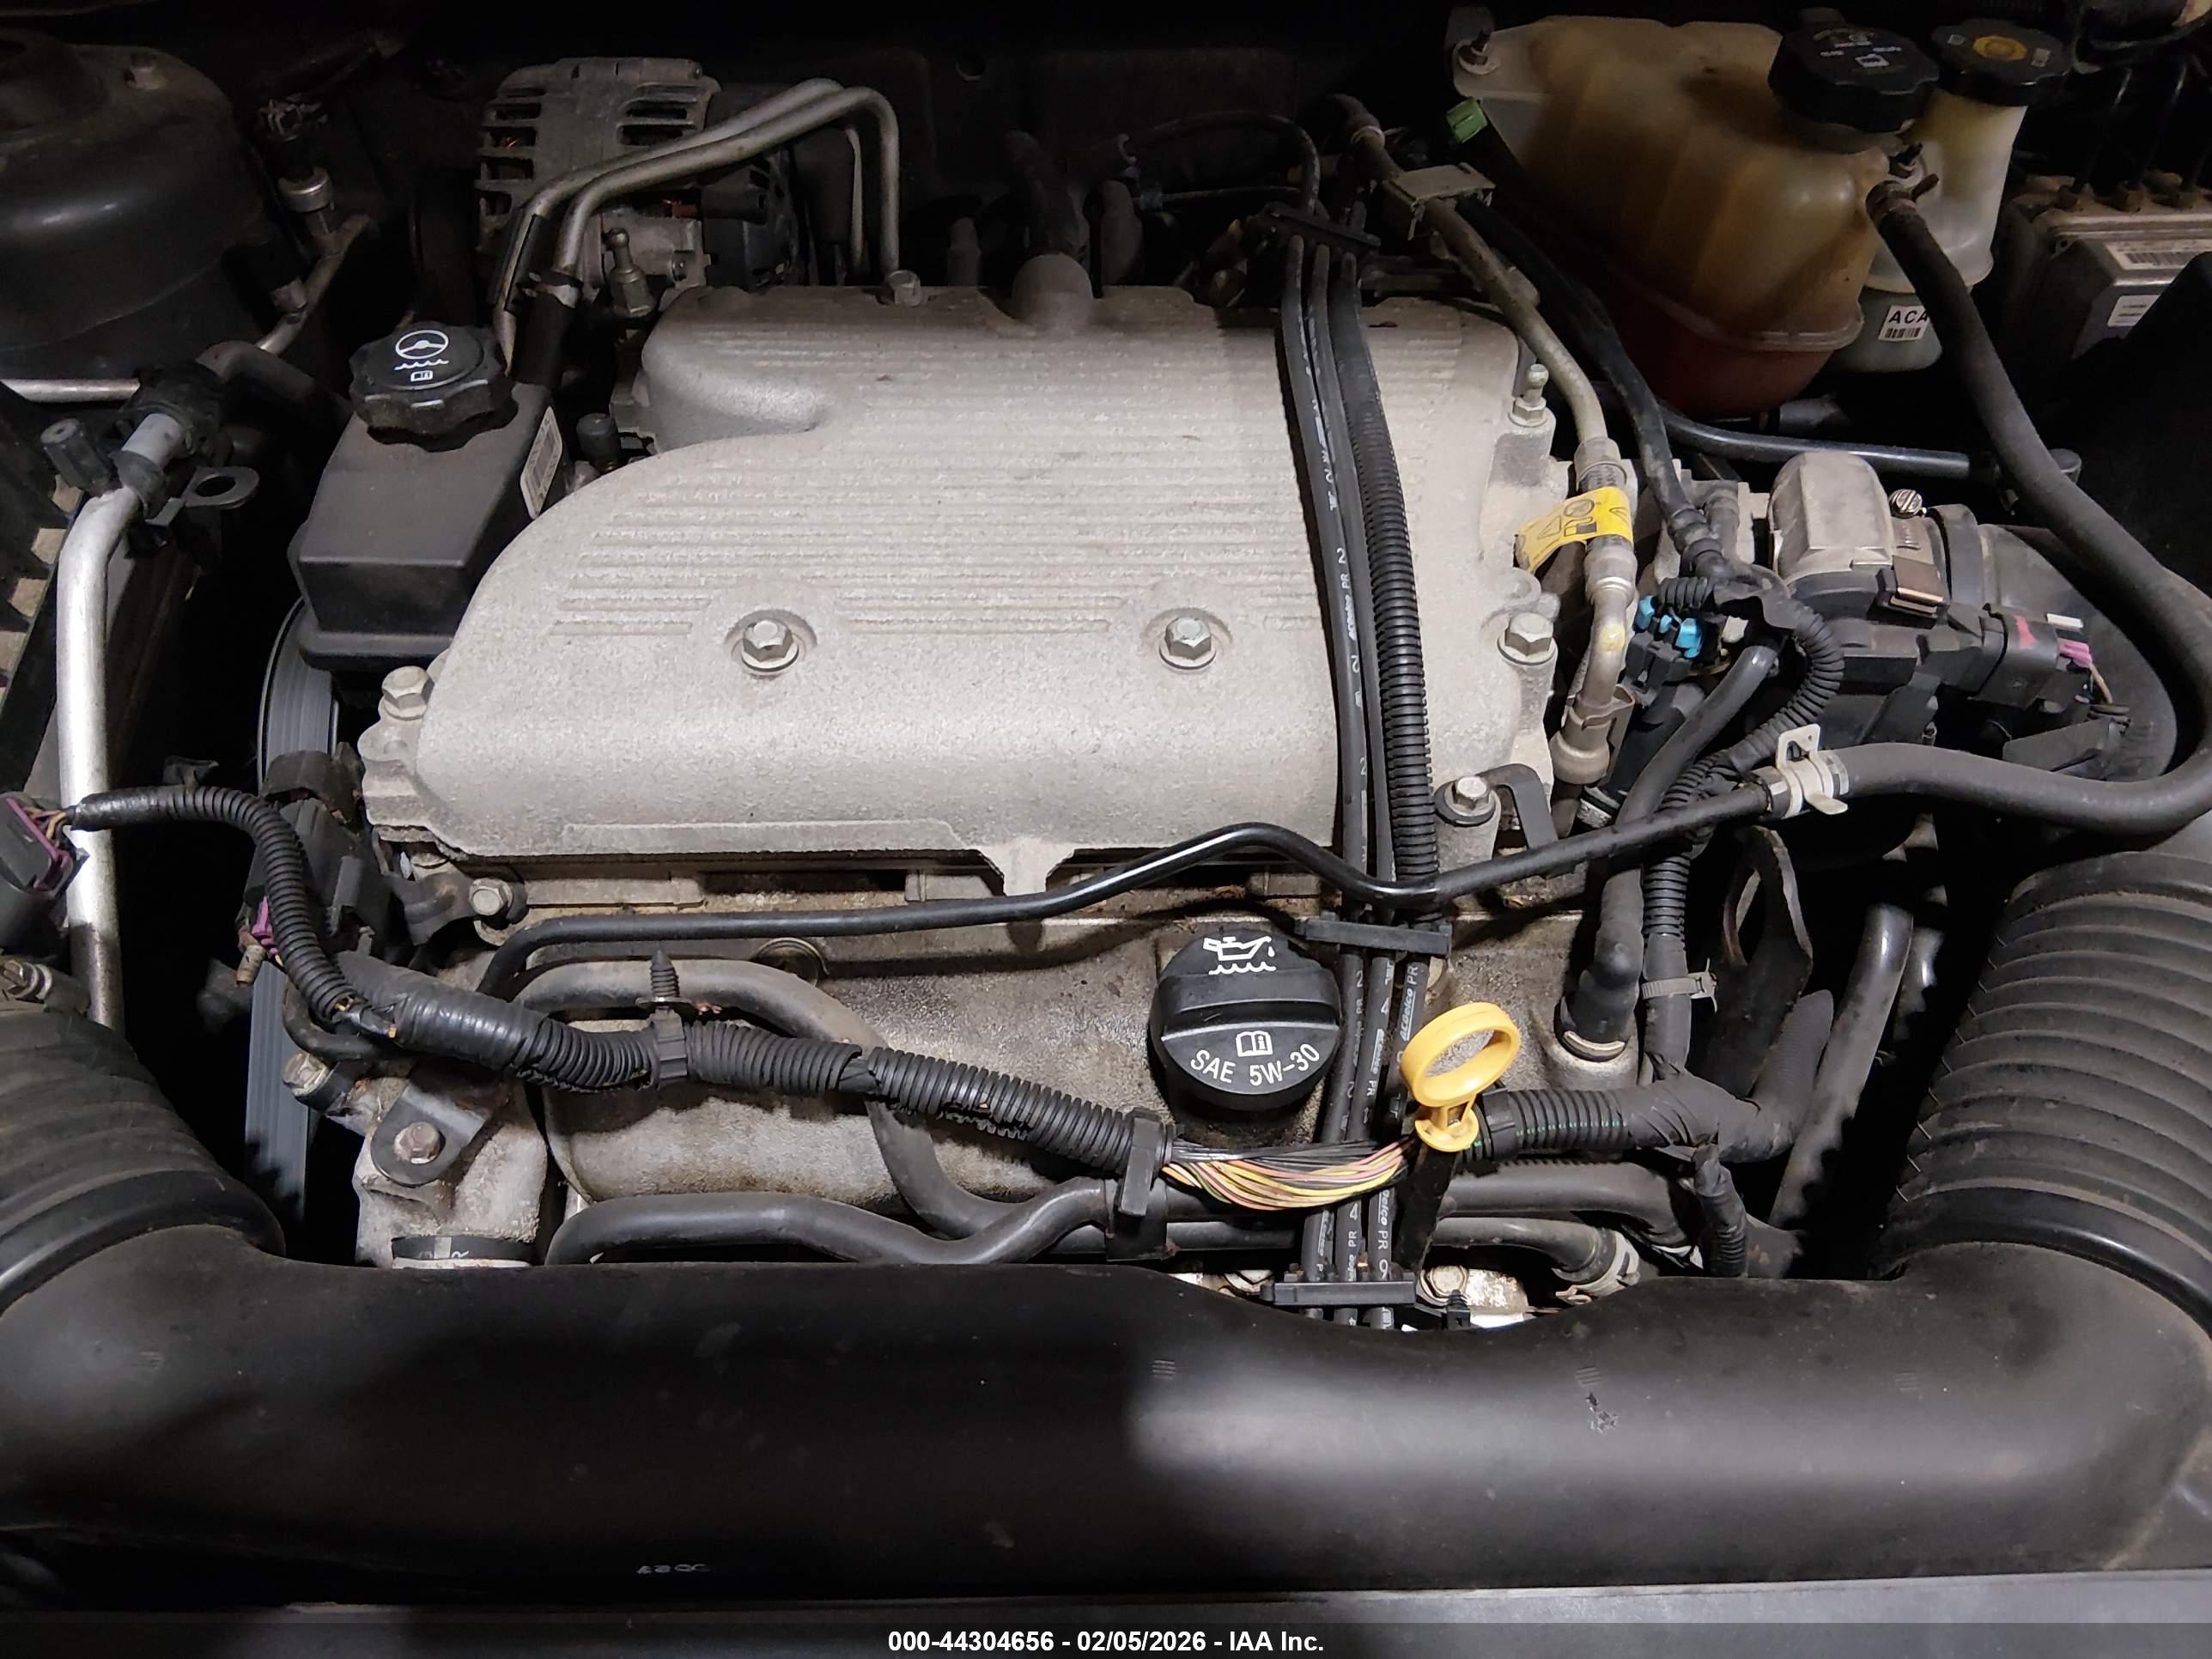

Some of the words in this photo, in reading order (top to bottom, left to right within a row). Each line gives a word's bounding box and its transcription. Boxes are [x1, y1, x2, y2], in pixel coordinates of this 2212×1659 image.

[1336, 547, 1346, 564] 2
[1407, 964, 1419, 986] PR
[1190, 1049, 1237, 1085] SAE
[1249, 1043, 1321, 1086] 5W-30
[1366, 1079, 1377, 1097] PR
[1349, 1202, 1358, 1221] 4
[1347, 1231, 1358, 1248] PR
[1377, 1230, 1389, 1251] PR
